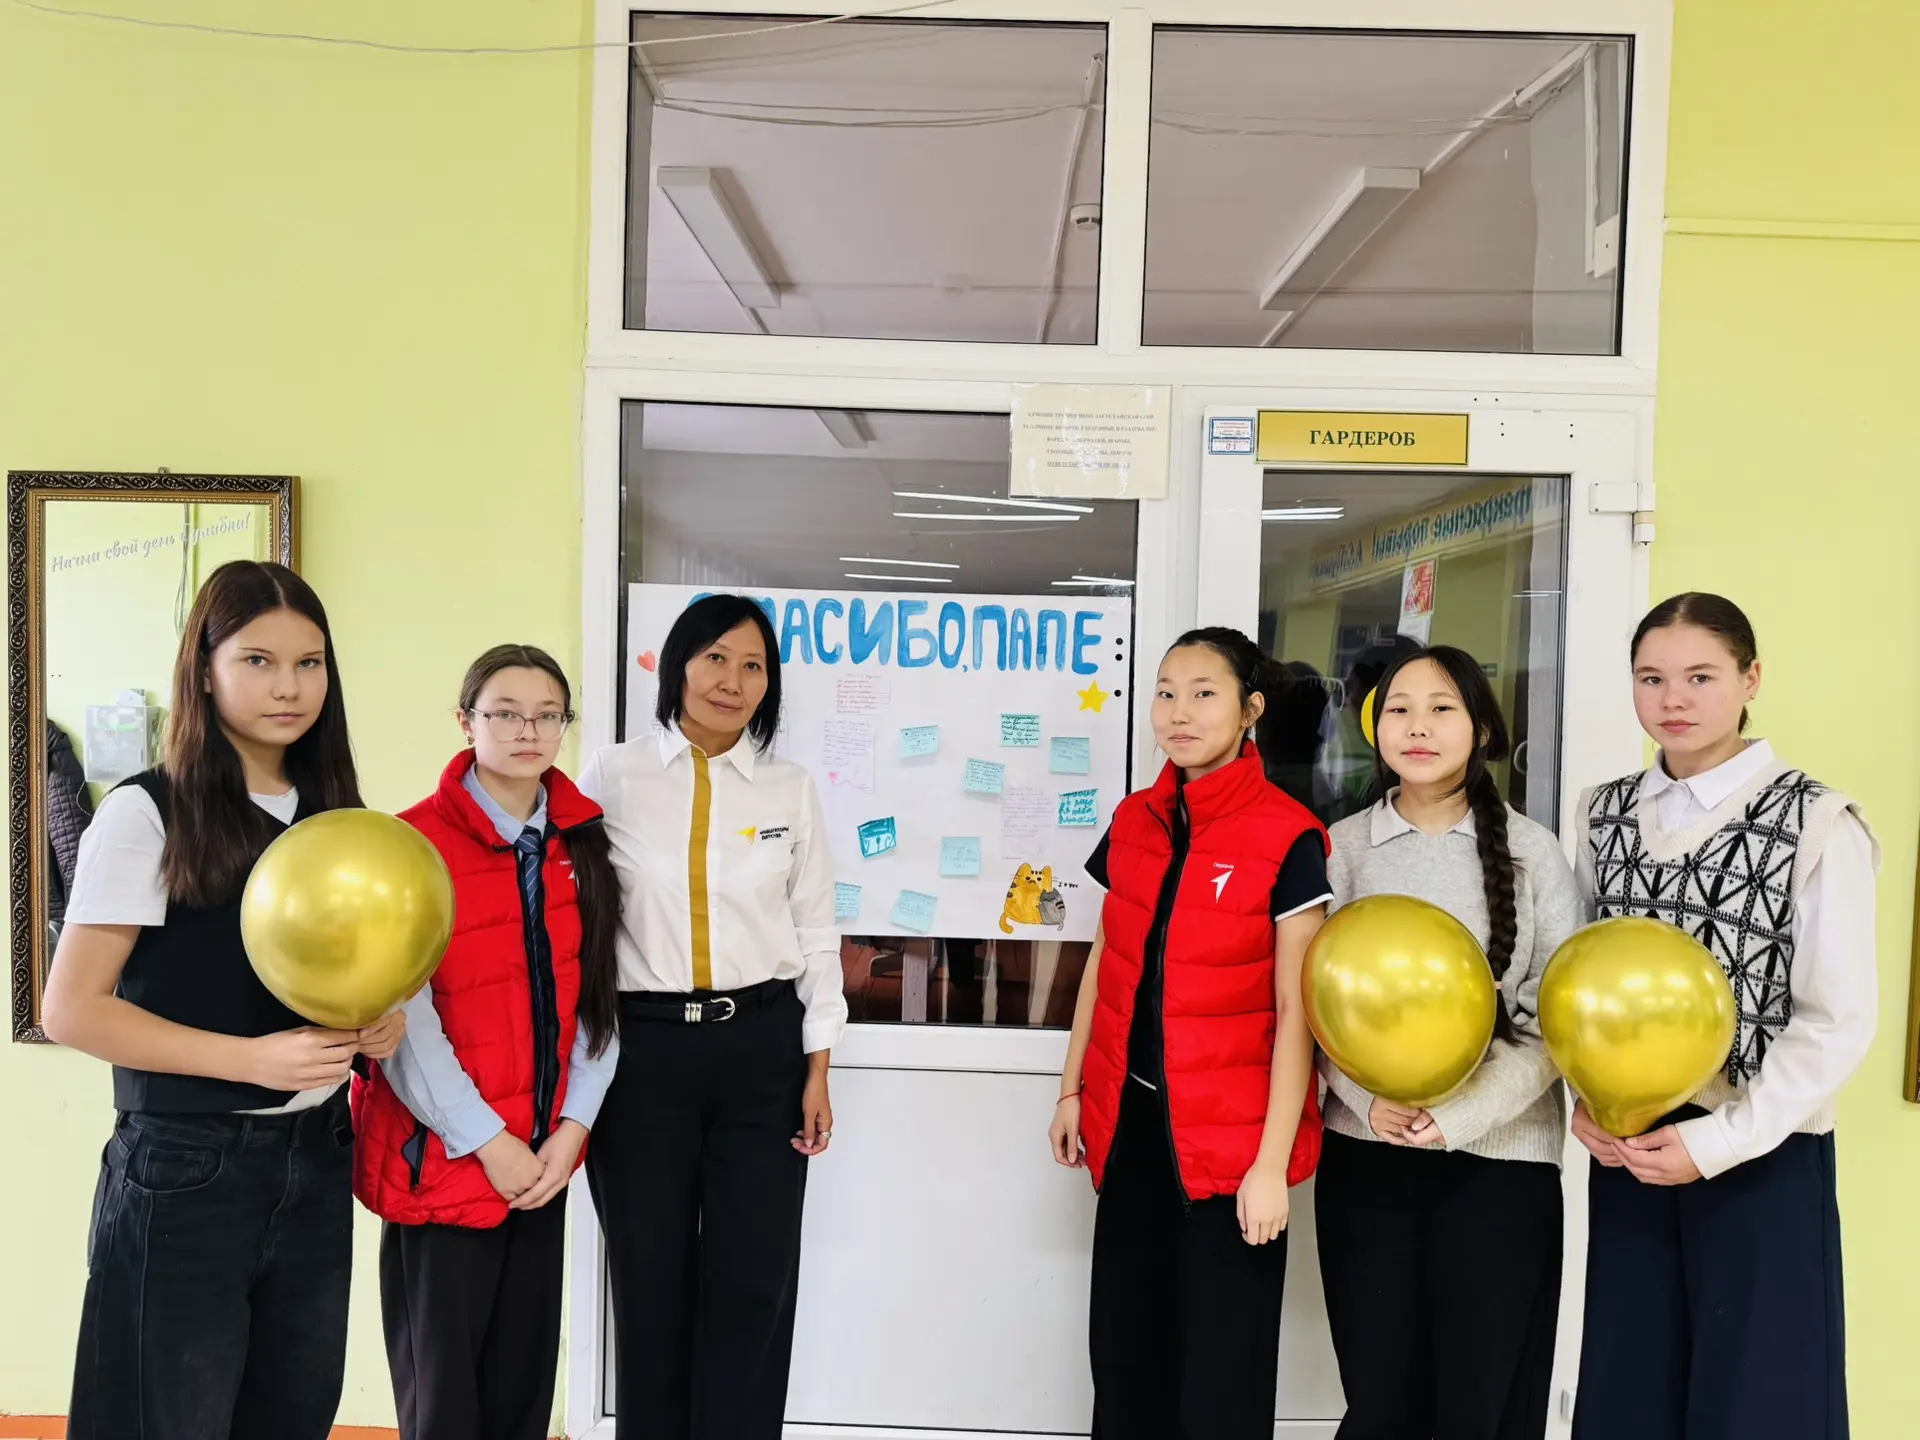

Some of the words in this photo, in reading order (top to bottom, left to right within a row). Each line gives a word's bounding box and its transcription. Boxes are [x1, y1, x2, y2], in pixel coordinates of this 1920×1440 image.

[1309, 430, 1416, 448] ГАРДЕРОБ
[52, 551, 100, 573] Начни
[105, 539, 139, 560] свой
[143, 534, 175, 558] день
[192, 511, 251, 546] улыбки!
[688, 592, 969, 672] АСИБО,
[972, 604, 1105, 675] ПАПЕ
